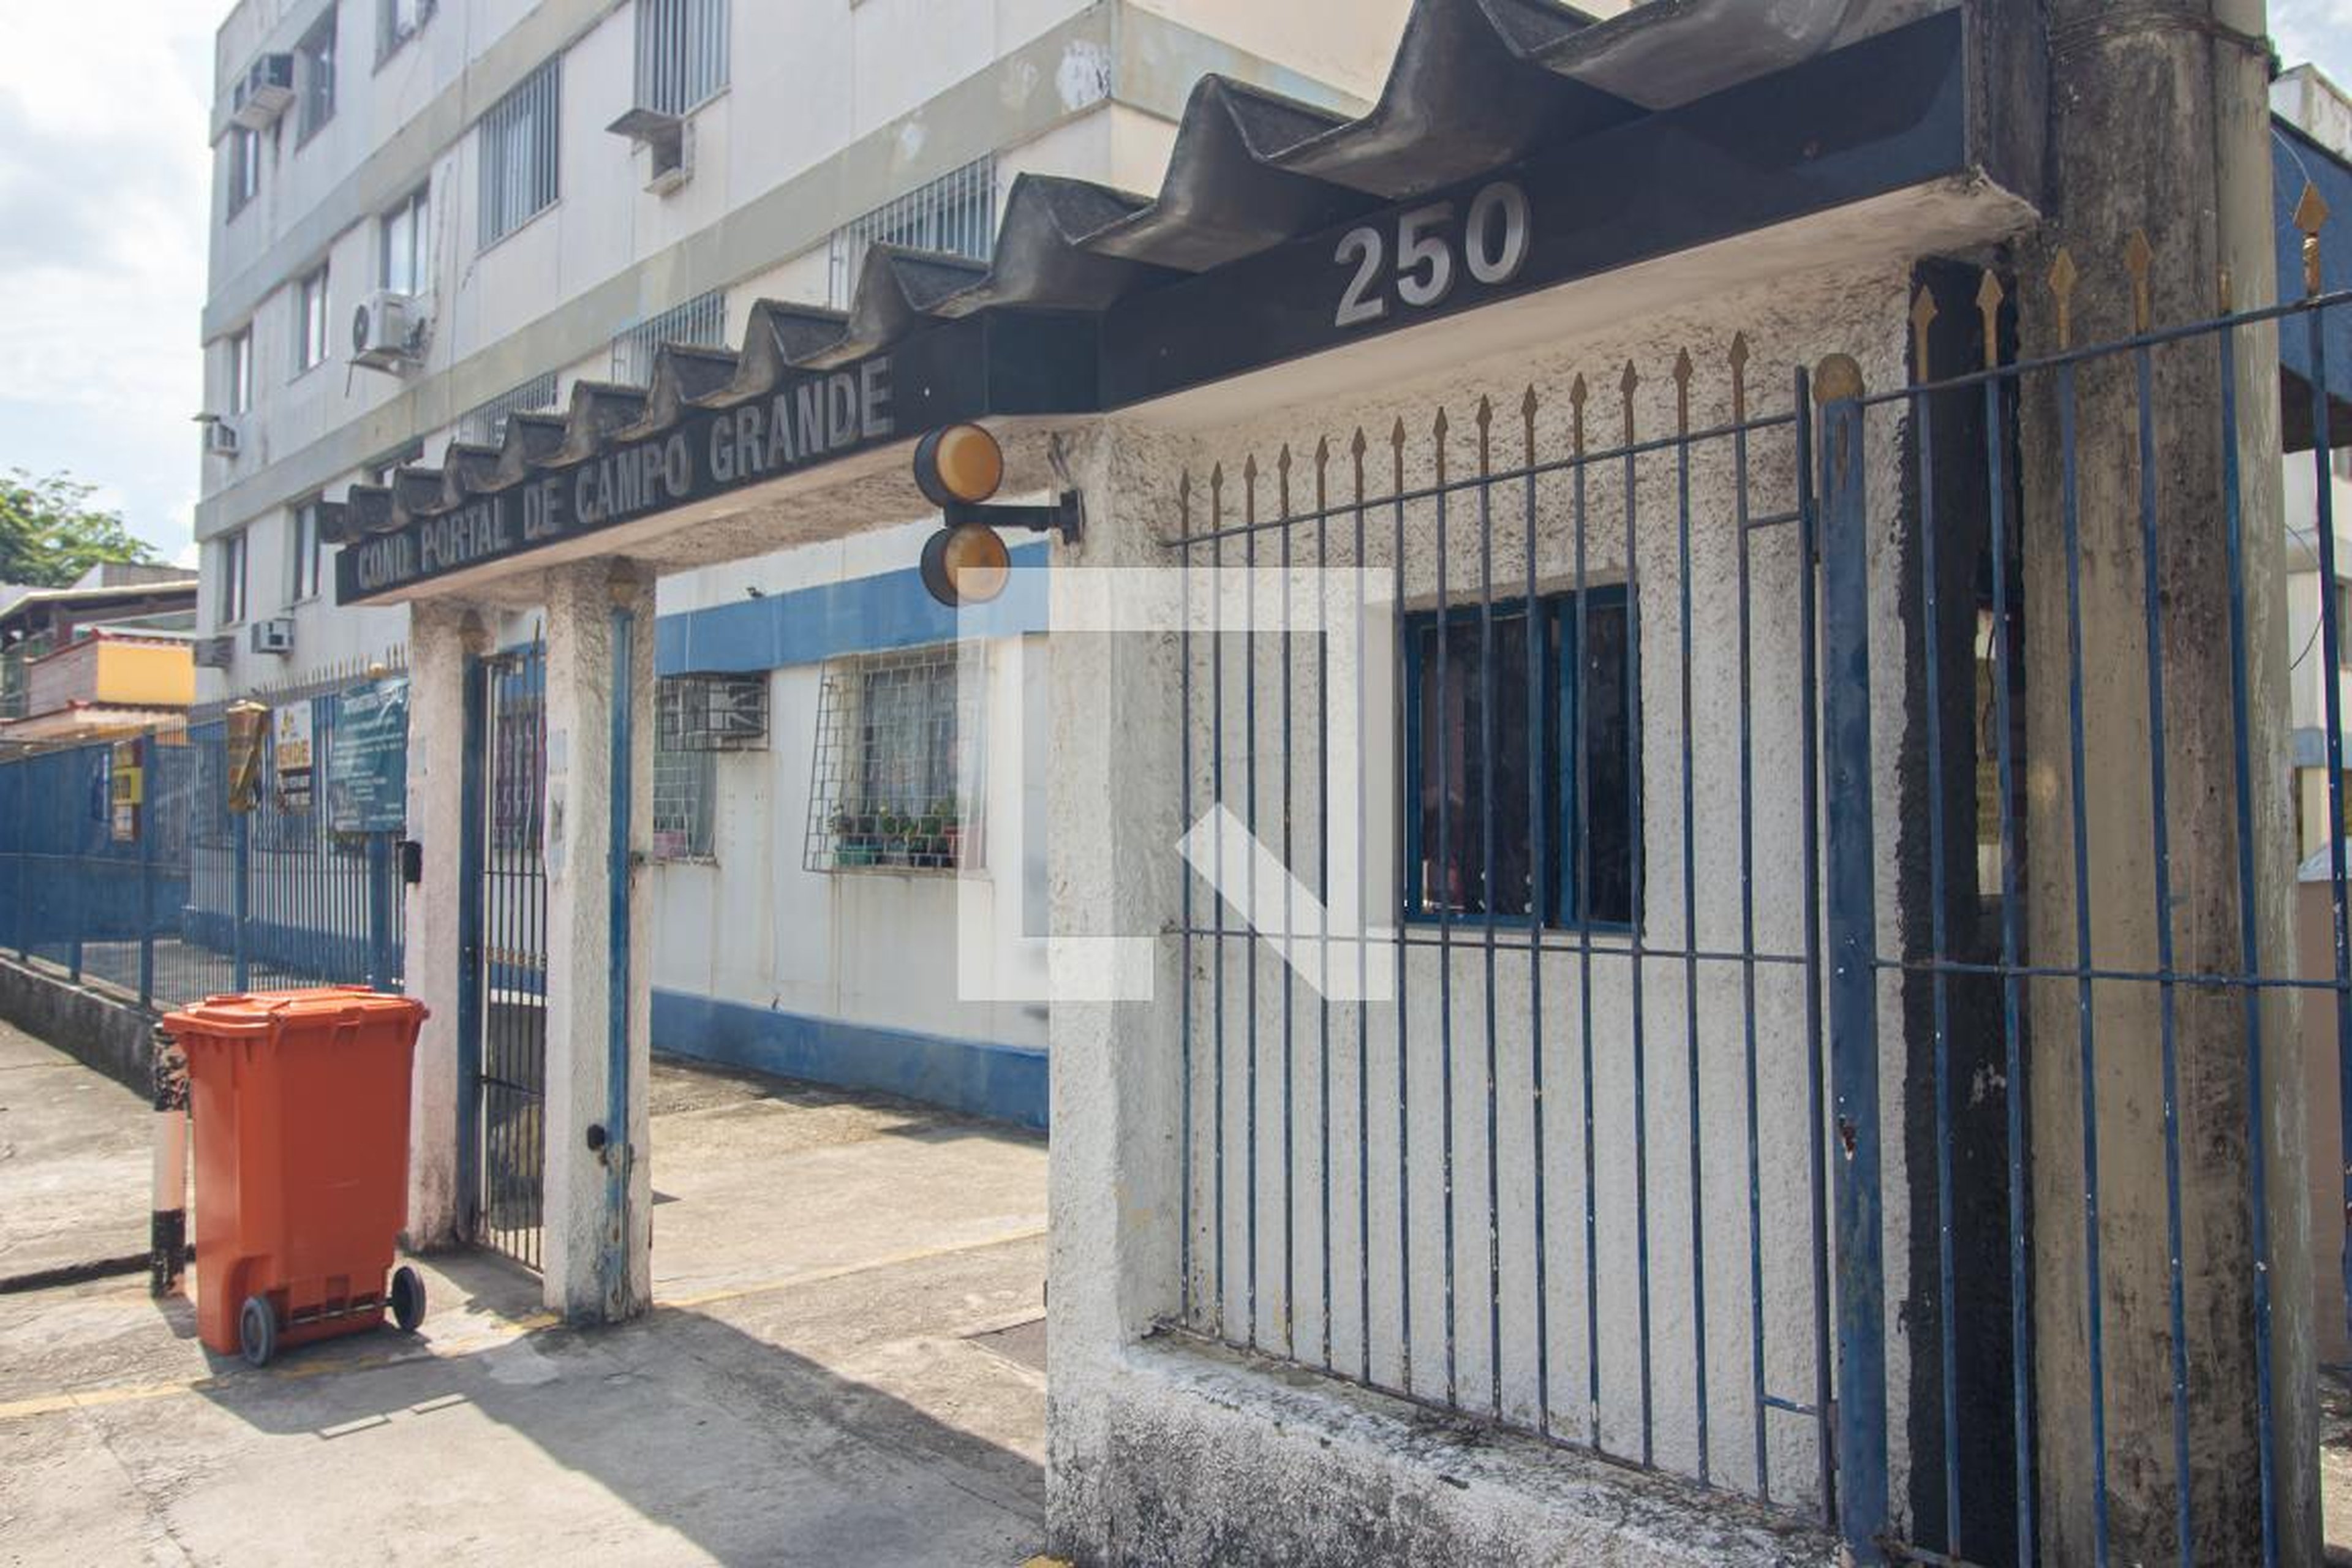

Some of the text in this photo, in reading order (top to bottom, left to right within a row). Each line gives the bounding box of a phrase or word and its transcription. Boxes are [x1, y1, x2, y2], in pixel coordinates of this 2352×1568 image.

[1334, 183, 1529, 327] 250
[421, 496, 510, 573] PORTAL
[523, 479, 564, 540] DE
[575, 434, 692, 524] CAMPO
[709, 356, 894, 483] GRANDE
